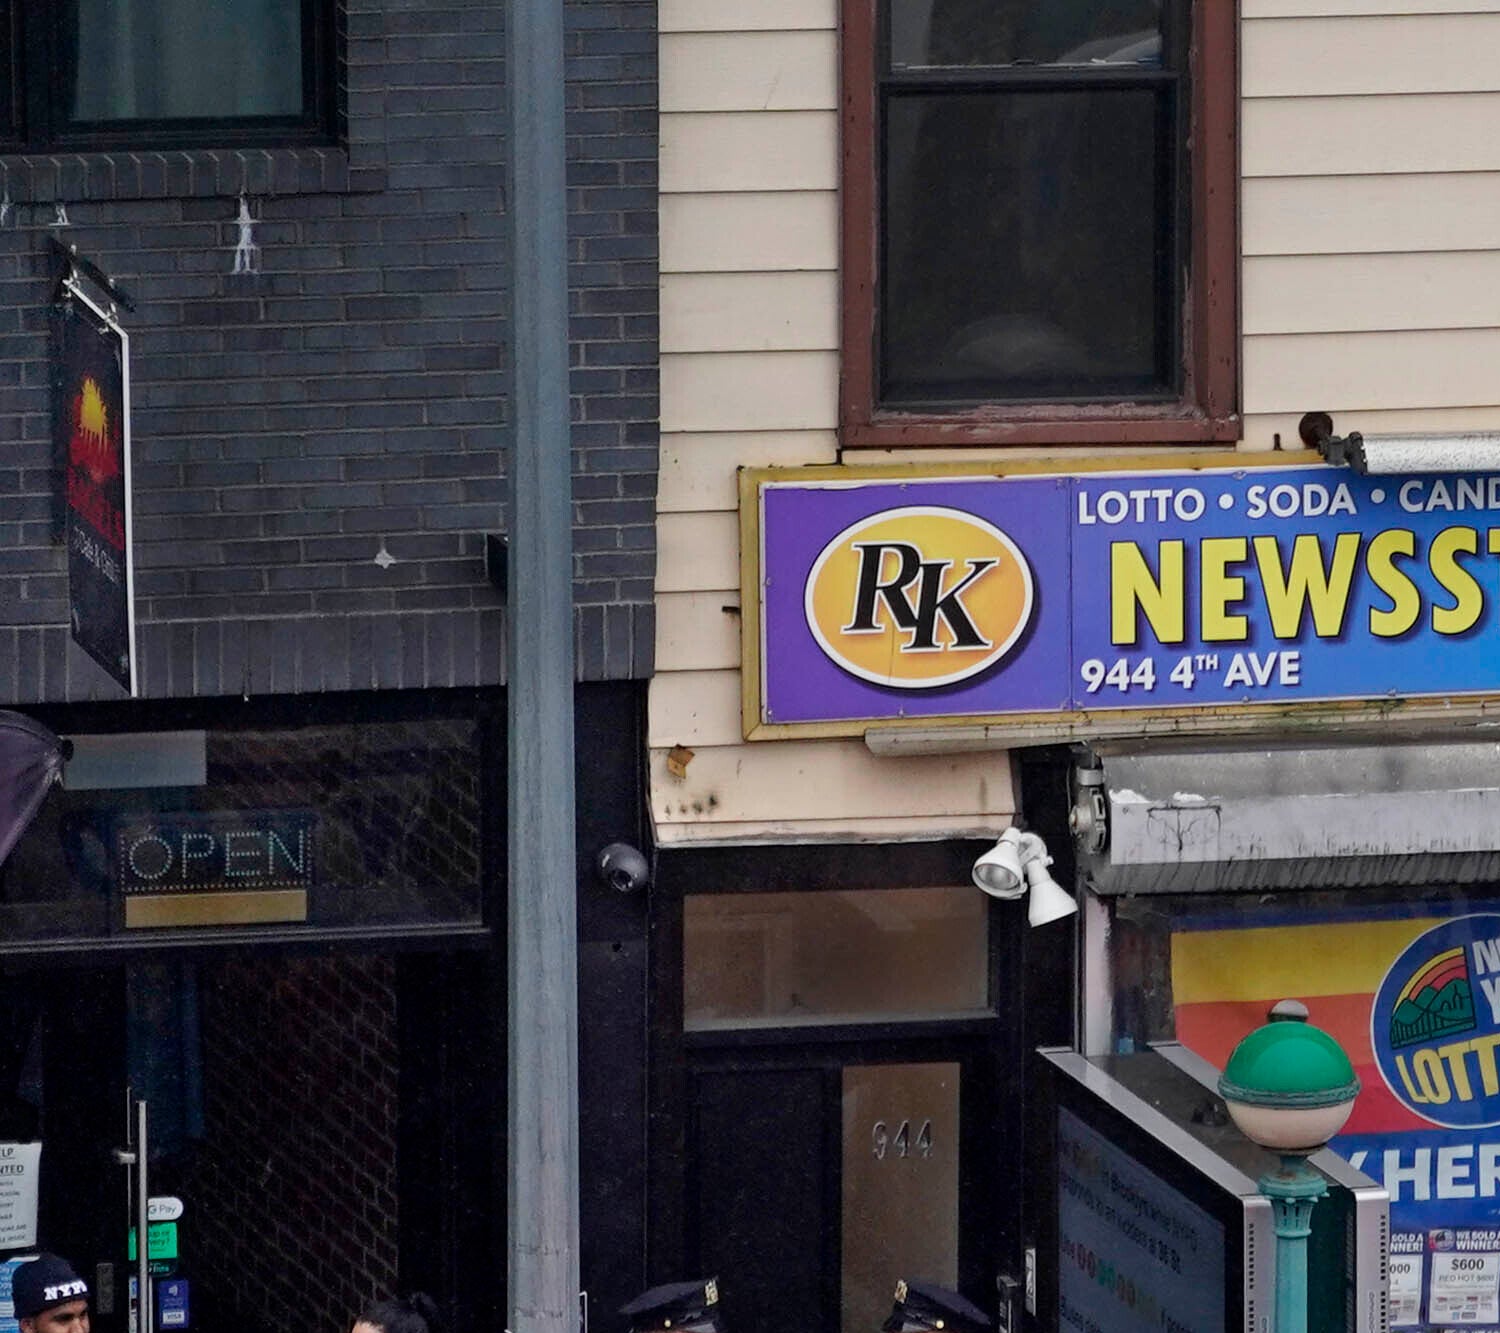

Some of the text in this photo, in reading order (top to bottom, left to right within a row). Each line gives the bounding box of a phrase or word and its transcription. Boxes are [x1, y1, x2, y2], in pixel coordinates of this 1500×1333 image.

[1078, 489, 1204, 526] LOTTO
[1246, 484, 1356, 519] SODA
[840, 540, 999, 652] RK
[1080, 659, 1157, 694] 944
[1223, 650, 1300, 690] AVE
[128, 830, 306, 884] OPEN
